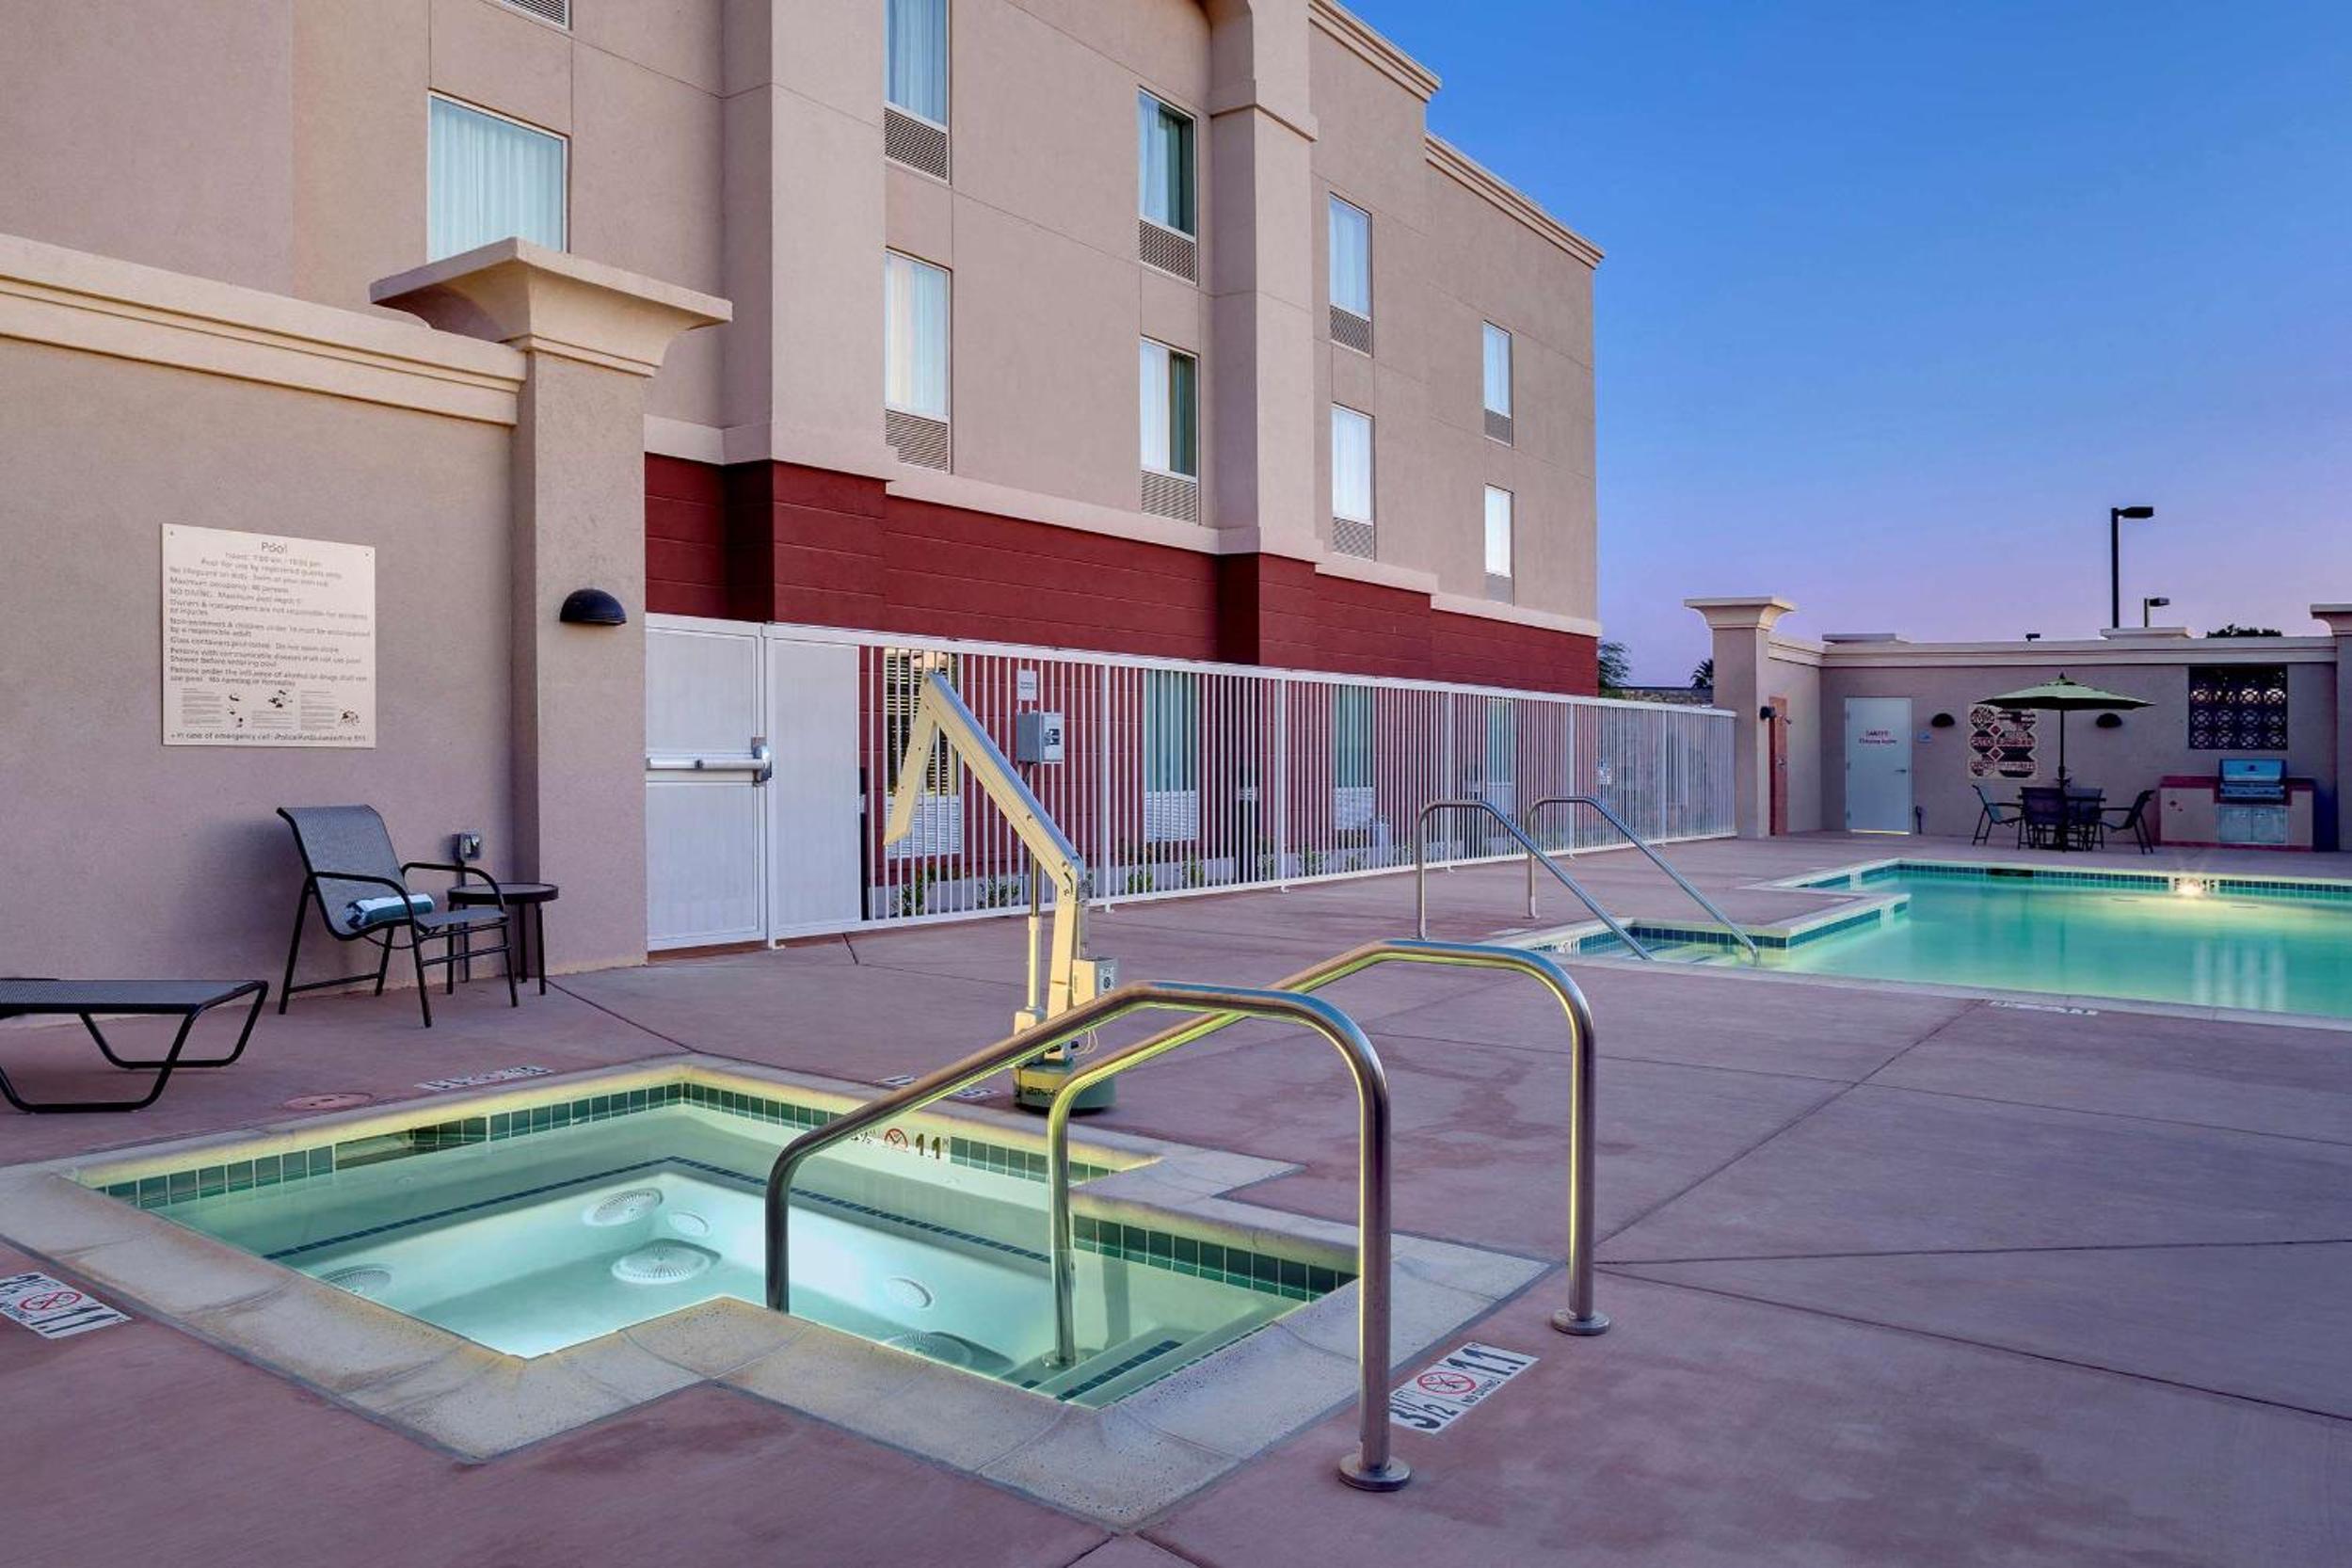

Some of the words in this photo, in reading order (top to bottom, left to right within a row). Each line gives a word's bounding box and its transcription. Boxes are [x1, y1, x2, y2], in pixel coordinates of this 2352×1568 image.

[261, 541, 287, 554] Pool
[916, 1133, 940, 1160] 1.1
[1447, 1348, 1527, 1376] 1.1
